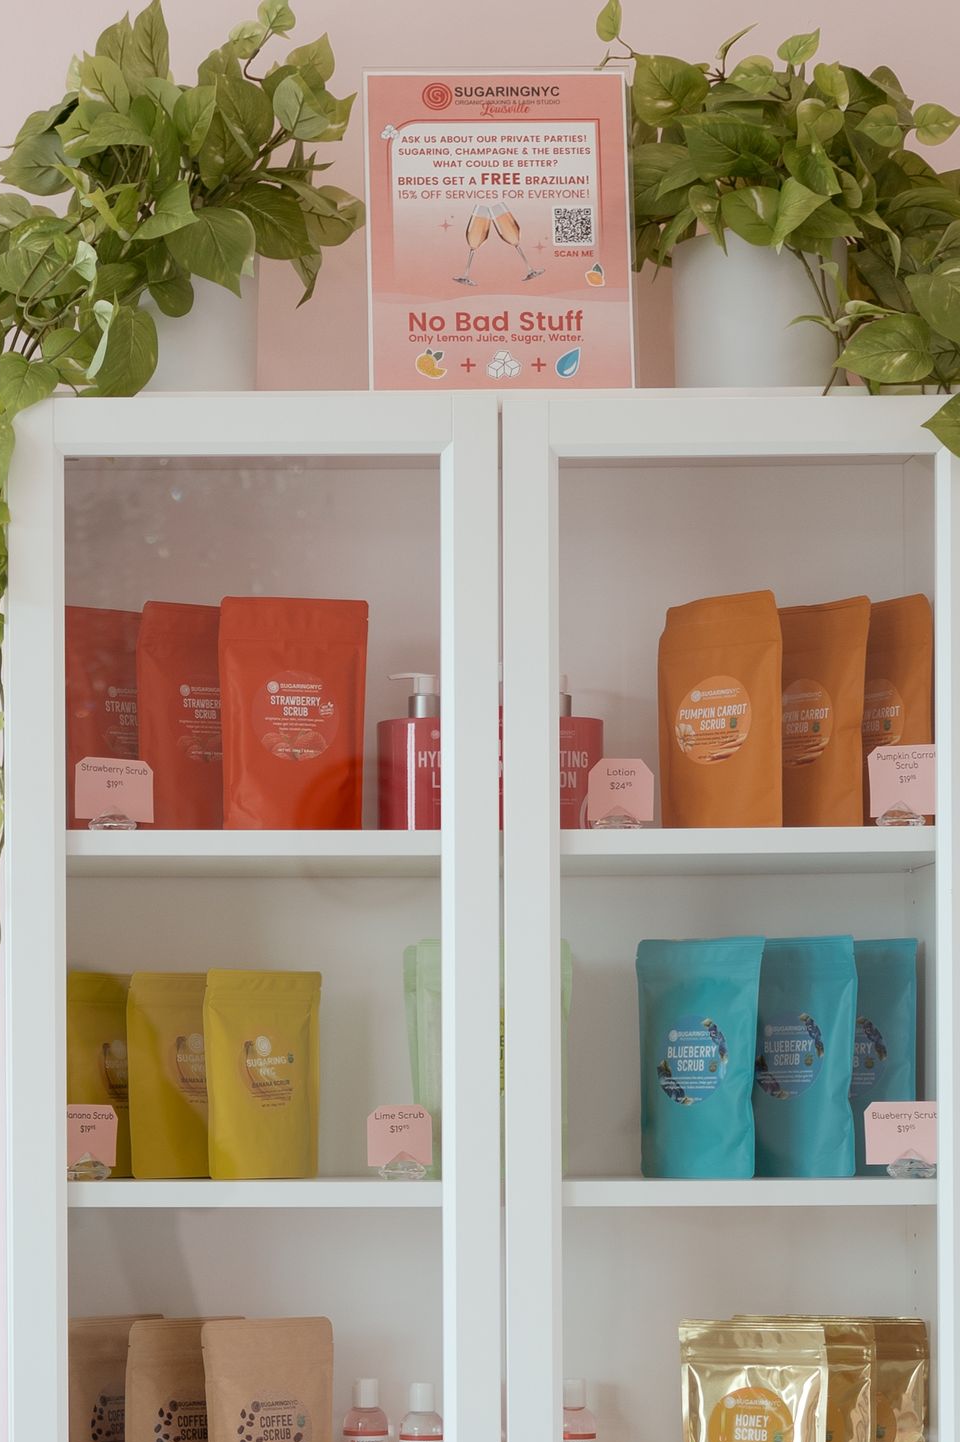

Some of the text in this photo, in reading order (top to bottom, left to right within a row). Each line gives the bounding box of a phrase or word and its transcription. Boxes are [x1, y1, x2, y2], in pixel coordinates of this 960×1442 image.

[455, 86, 560, 97] SUGARINGNYC
[399, 148, 452, 156] SUGARING,
[398, 172, 589, 185] BRIDES GET A FREE BRAZILIAN!
[399, 189, 589, 199] 15% OFF SERVICES FOR EVERYONE!
[409, 310, 583, 331] No Bad Stuff
[409, 333, 583, 344] Only Lemon Juice, Sugar, Water.
[271, 696, 320, 706] STRAWBERRY
[283, 707, 308, 717] SCRUB
[680, 704, 747, 720] PUMPKIN CARROT
[701, 718, 725, 730] SCRUB
[877, 753, 909, 762] Pumpkin
[81, 763, 148, 775] Strawberry Scrub
[607, 768, 636, 777] Lotion
[668, 1046, 716, 1058] BLUEBERRY
[677, 1060, 704, 1072] SCRUB
[398, 1111, 424, 1119] Scrub
[872, 1112, 912, 1120] Blueberry
[260, 1415, 292, 1428] COFFEE
[736, 1415, 769, 1427] HONEY
[263, 1428, 291, 1440] SCRUB
[735, 1428, 767, 1441] SCRUB
